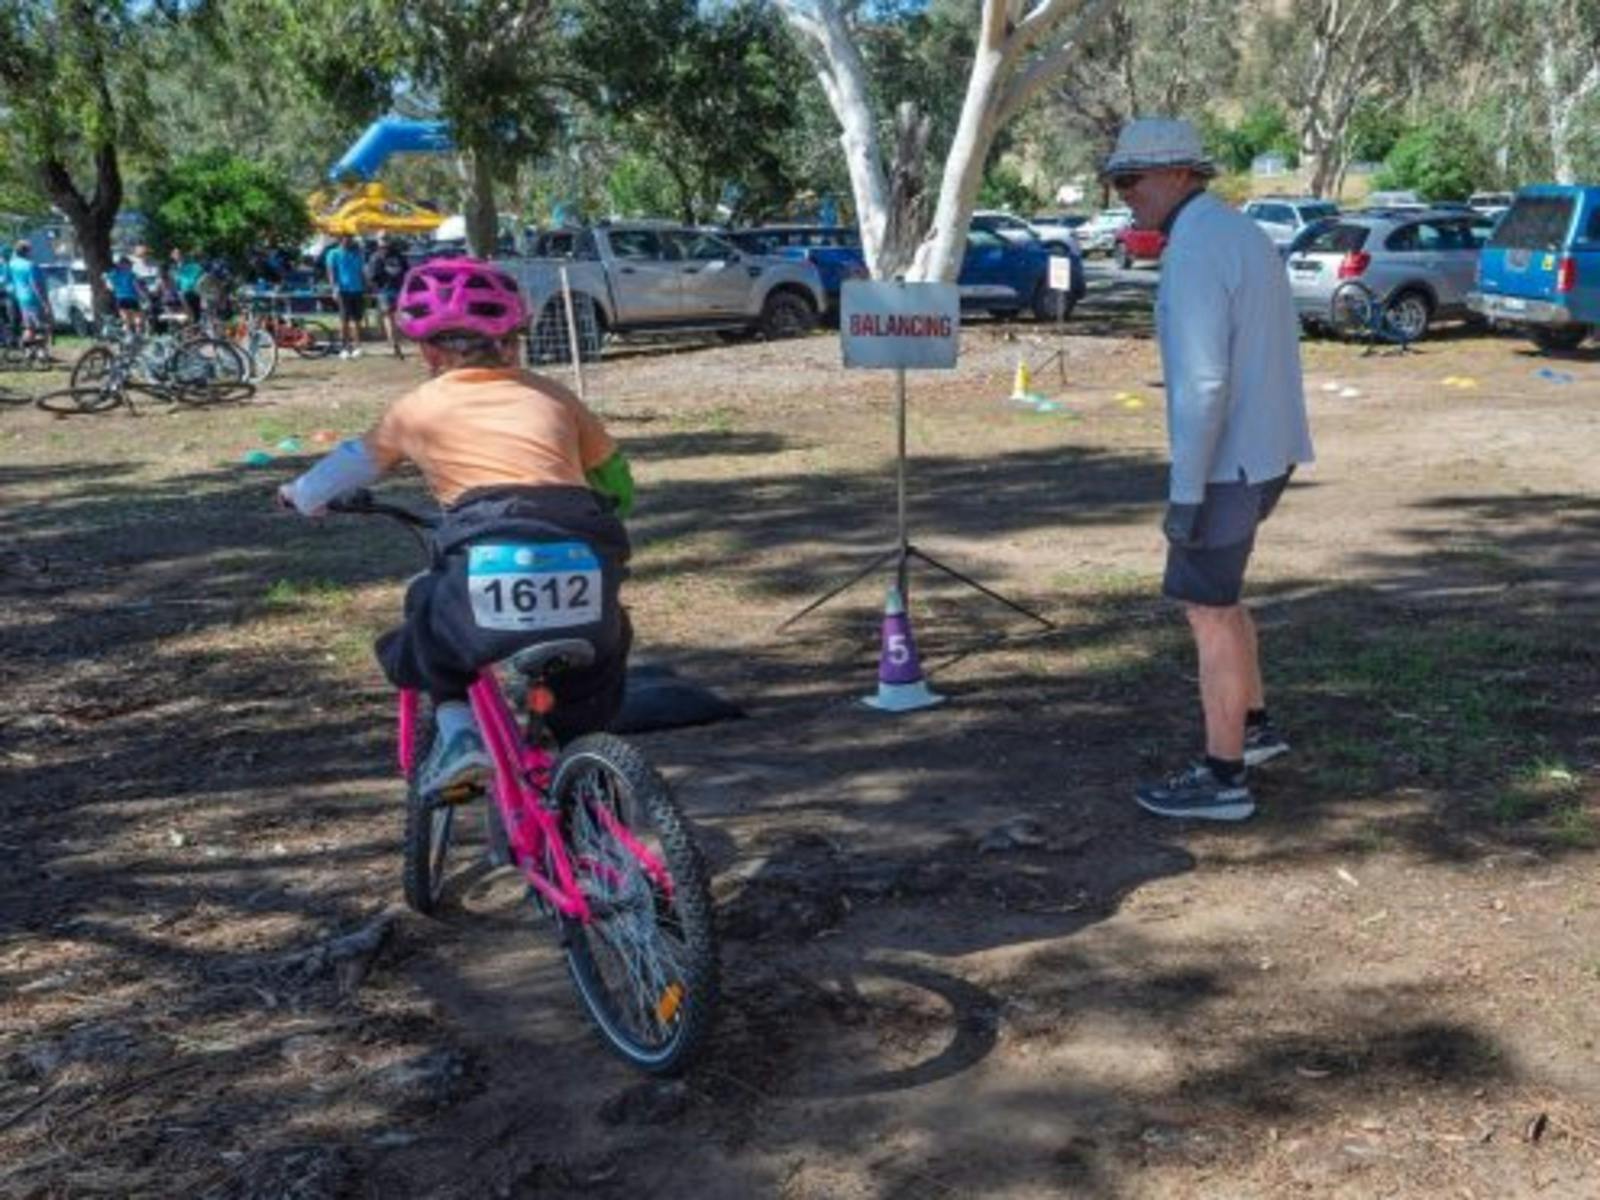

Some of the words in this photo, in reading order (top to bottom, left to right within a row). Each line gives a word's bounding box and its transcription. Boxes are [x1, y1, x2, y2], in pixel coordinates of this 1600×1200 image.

[849, 313, 951, 336] BALANCING
[484, 575, 590, 613] 1612
[888, 634, 909, 665] 5
